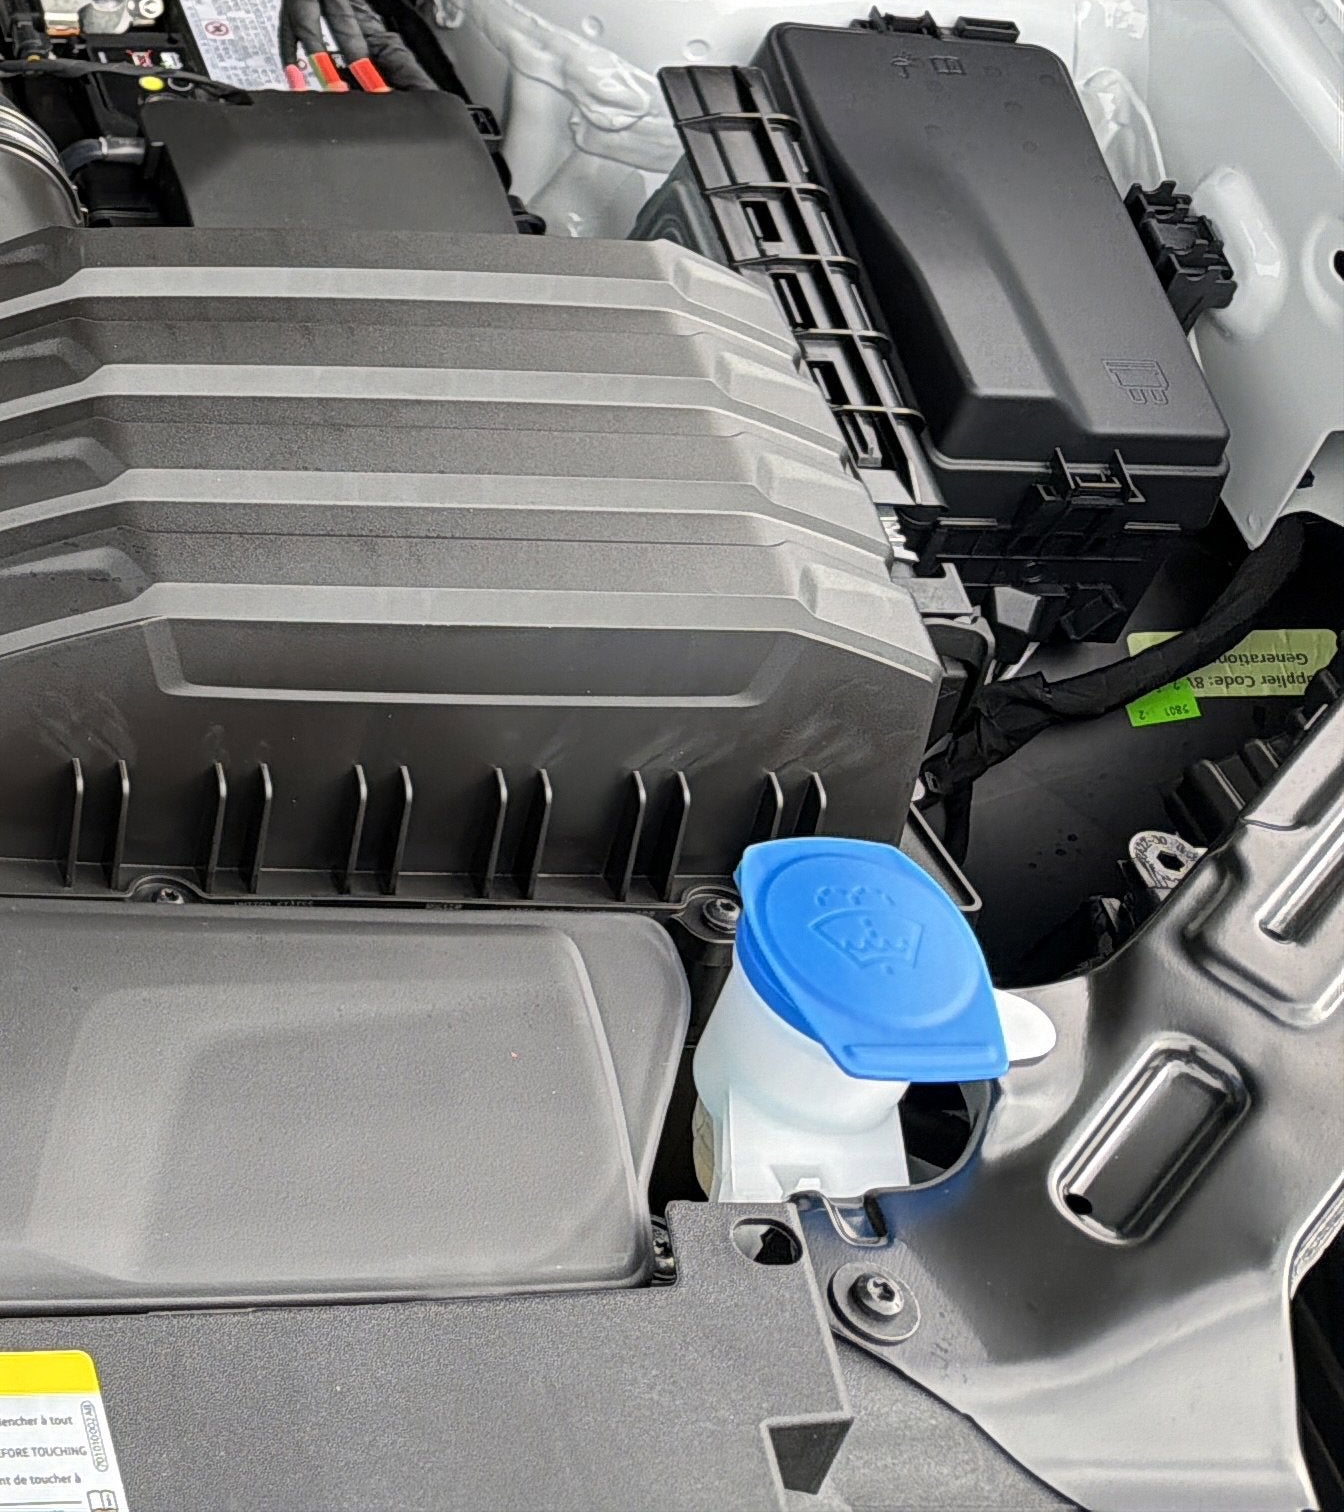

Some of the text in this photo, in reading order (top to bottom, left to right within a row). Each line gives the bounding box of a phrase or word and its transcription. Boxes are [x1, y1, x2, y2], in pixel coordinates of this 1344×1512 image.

[1211, 675, 1256, 688] Code:
[40, 1415, 47, 1425] à
[49, 1416, 74, 1426] tout
[30, 1445, 88, 1457] TOUCHING
[13, 1474, 27, 1485] de
[29, 1473, 72, 1485] toucher
[74, 1472, 82, 1484] à
